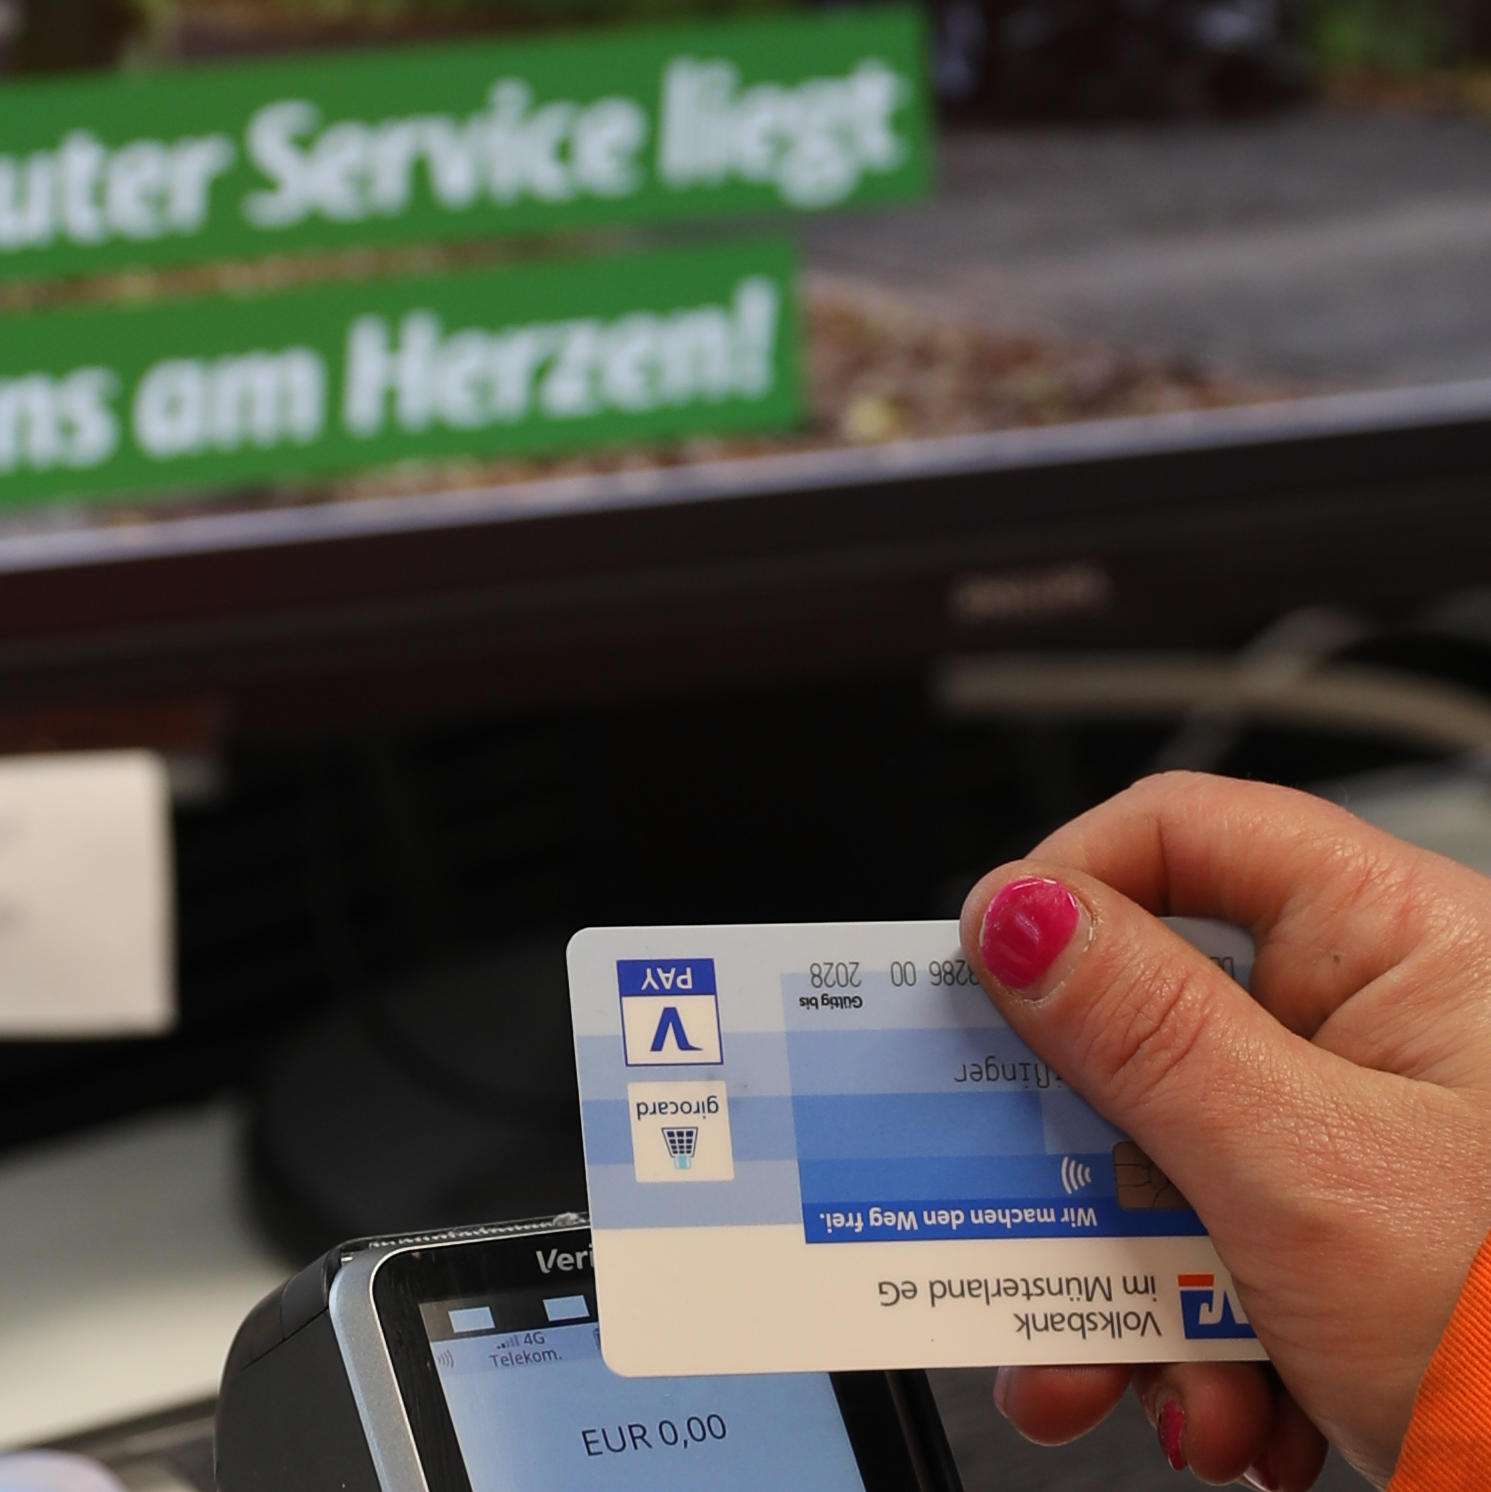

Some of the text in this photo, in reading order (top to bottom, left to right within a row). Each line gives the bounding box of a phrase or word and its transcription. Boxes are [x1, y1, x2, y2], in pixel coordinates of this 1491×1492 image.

[239, 76, 649, 225] Service
[659, 56, 908, 206] liegt
[136, 343, 322, 457] am
[342, 274, 779, 437] Herzen!
[641, 967, 693, 991] PAY
[809, 961, 862, 988] 2028
[799, 993, 863, 1010] Gültig bis
[636, 1095, 719, 1121] girocard
[819, 1206, 1098, 1234] Wir machen den Weg frei.
[878, 1275, 1157, 1308] im Münsterland eG
[523, 1331, 545, 1346] 4G
[1013, 1310, 1162, 1341] Volksbank
[489, 1349, 562, 1368] Telekom.
[581, 1413, 727, 1457] EUR 0,00
